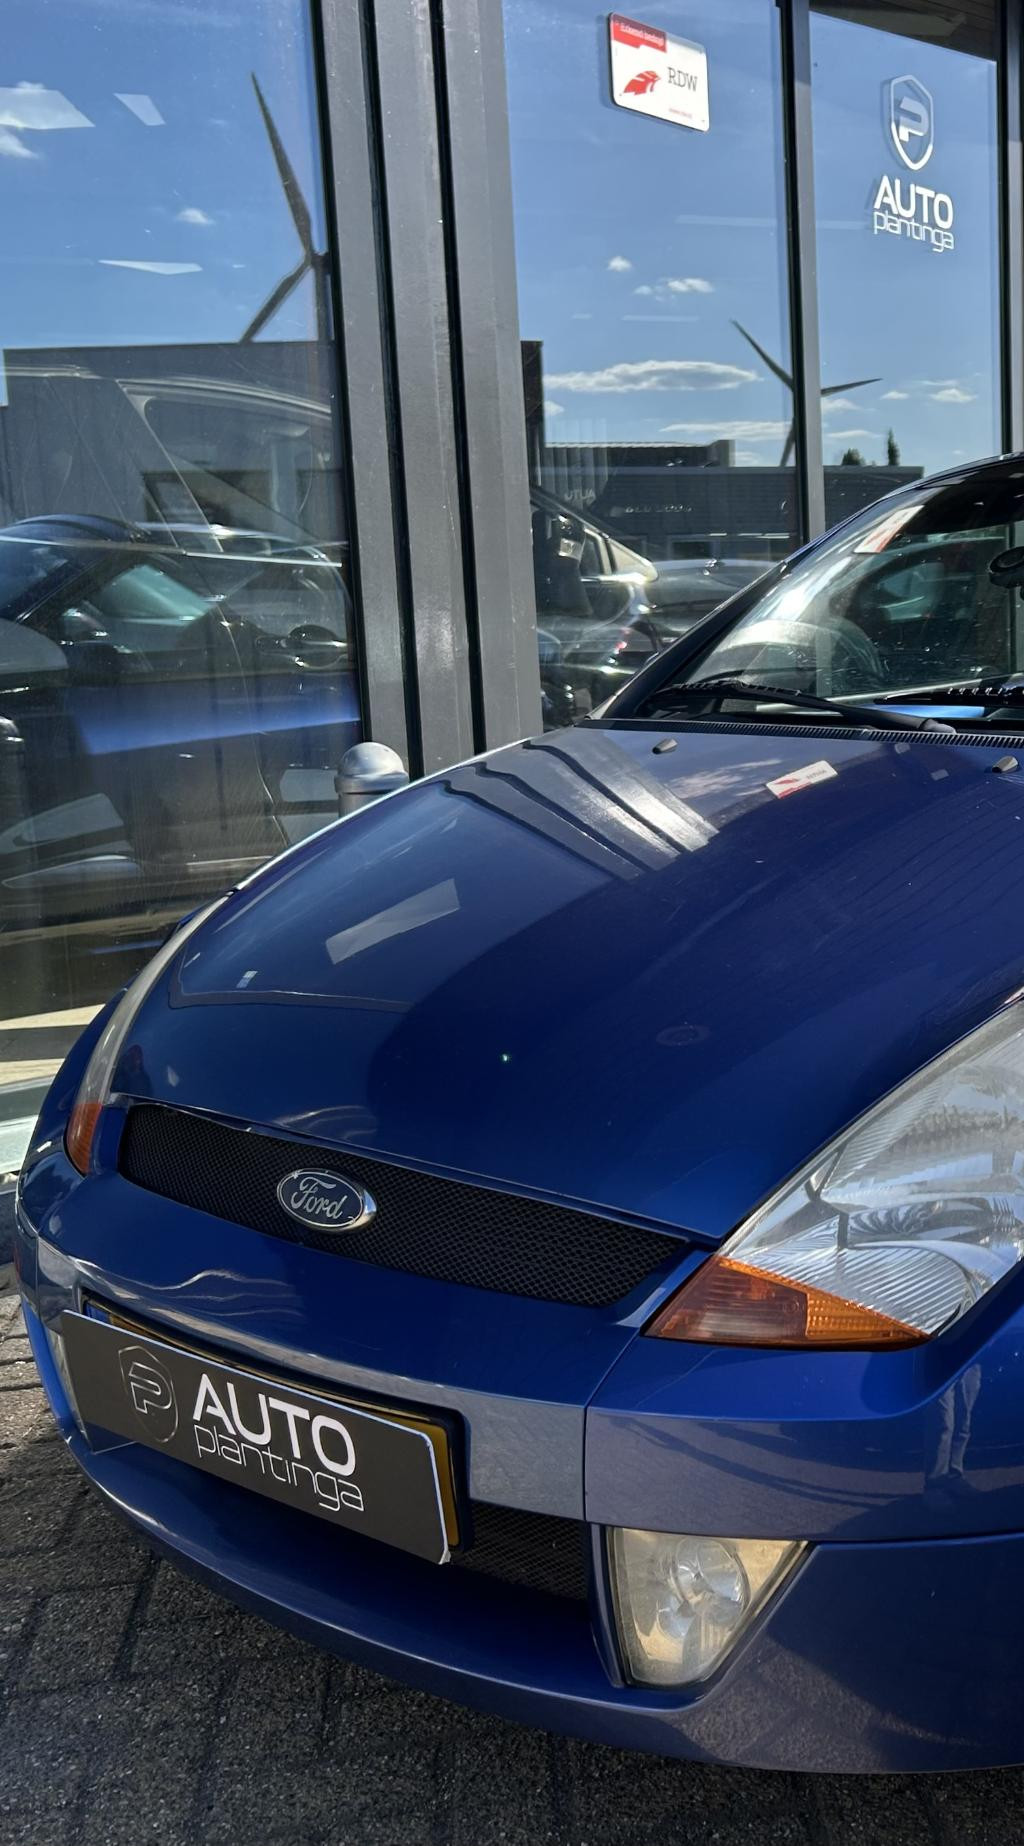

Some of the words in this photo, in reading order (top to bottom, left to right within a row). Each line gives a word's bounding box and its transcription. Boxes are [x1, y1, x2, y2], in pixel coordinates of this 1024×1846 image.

[667, 66, 699, 92] RDW
[873, 174, 954, 230] AUTO
[873, 209, 955, 253] plantinga
[290, 1176, 349, 1222] Ford
[192, 1372, 357, 1477] AUTO
[193, 1424, 365, 1512] plantinga
